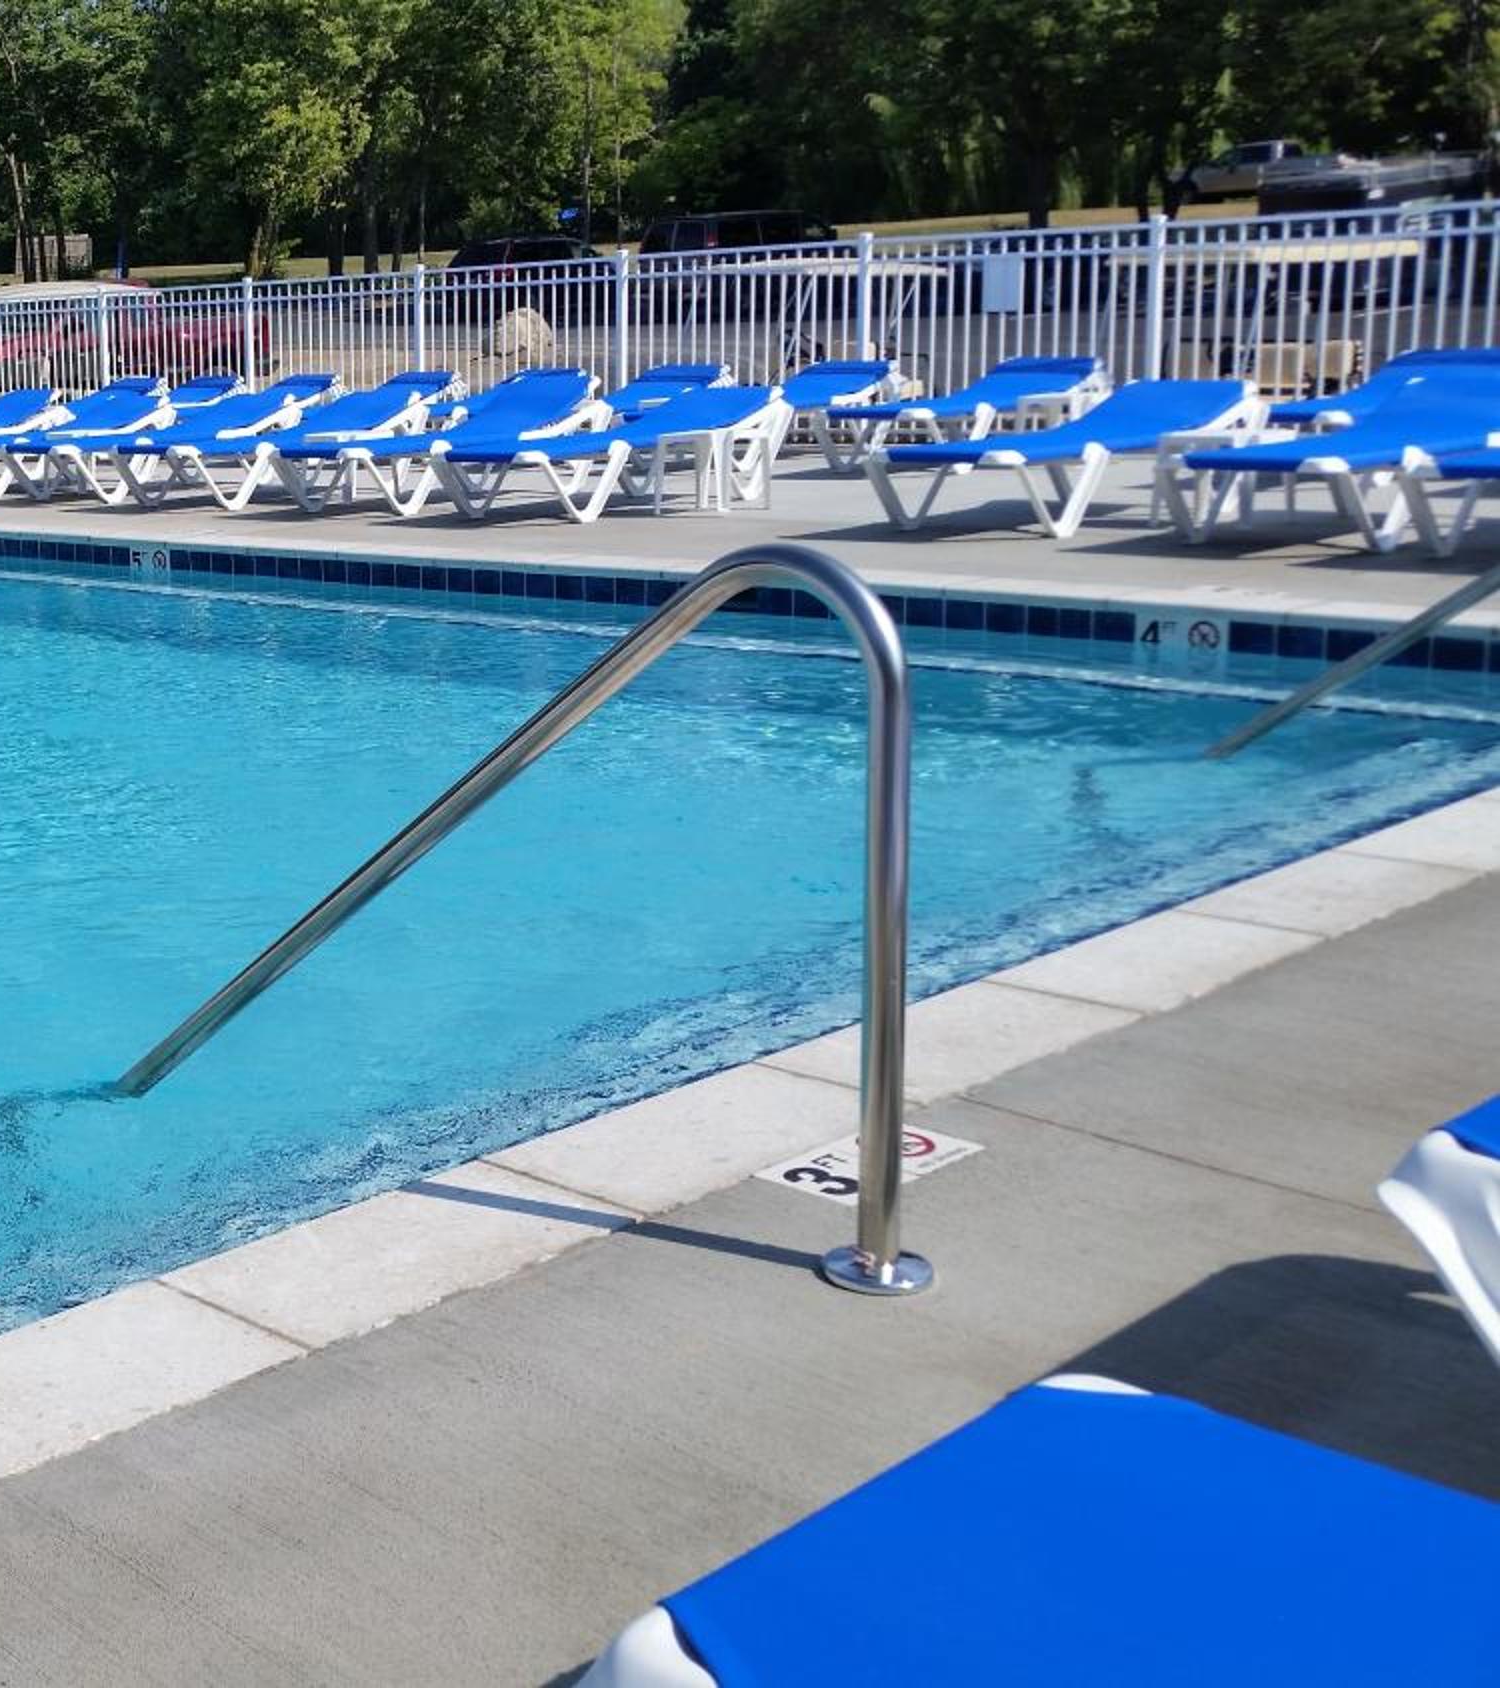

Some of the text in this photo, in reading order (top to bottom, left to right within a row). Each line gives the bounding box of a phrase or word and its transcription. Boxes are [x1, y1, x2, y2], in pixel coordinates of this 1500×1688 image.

[131, 550, 142, 567] 5
[1141, 620, 1160, 642] 4
[782, 1153, 860, 1195] 3 FT
